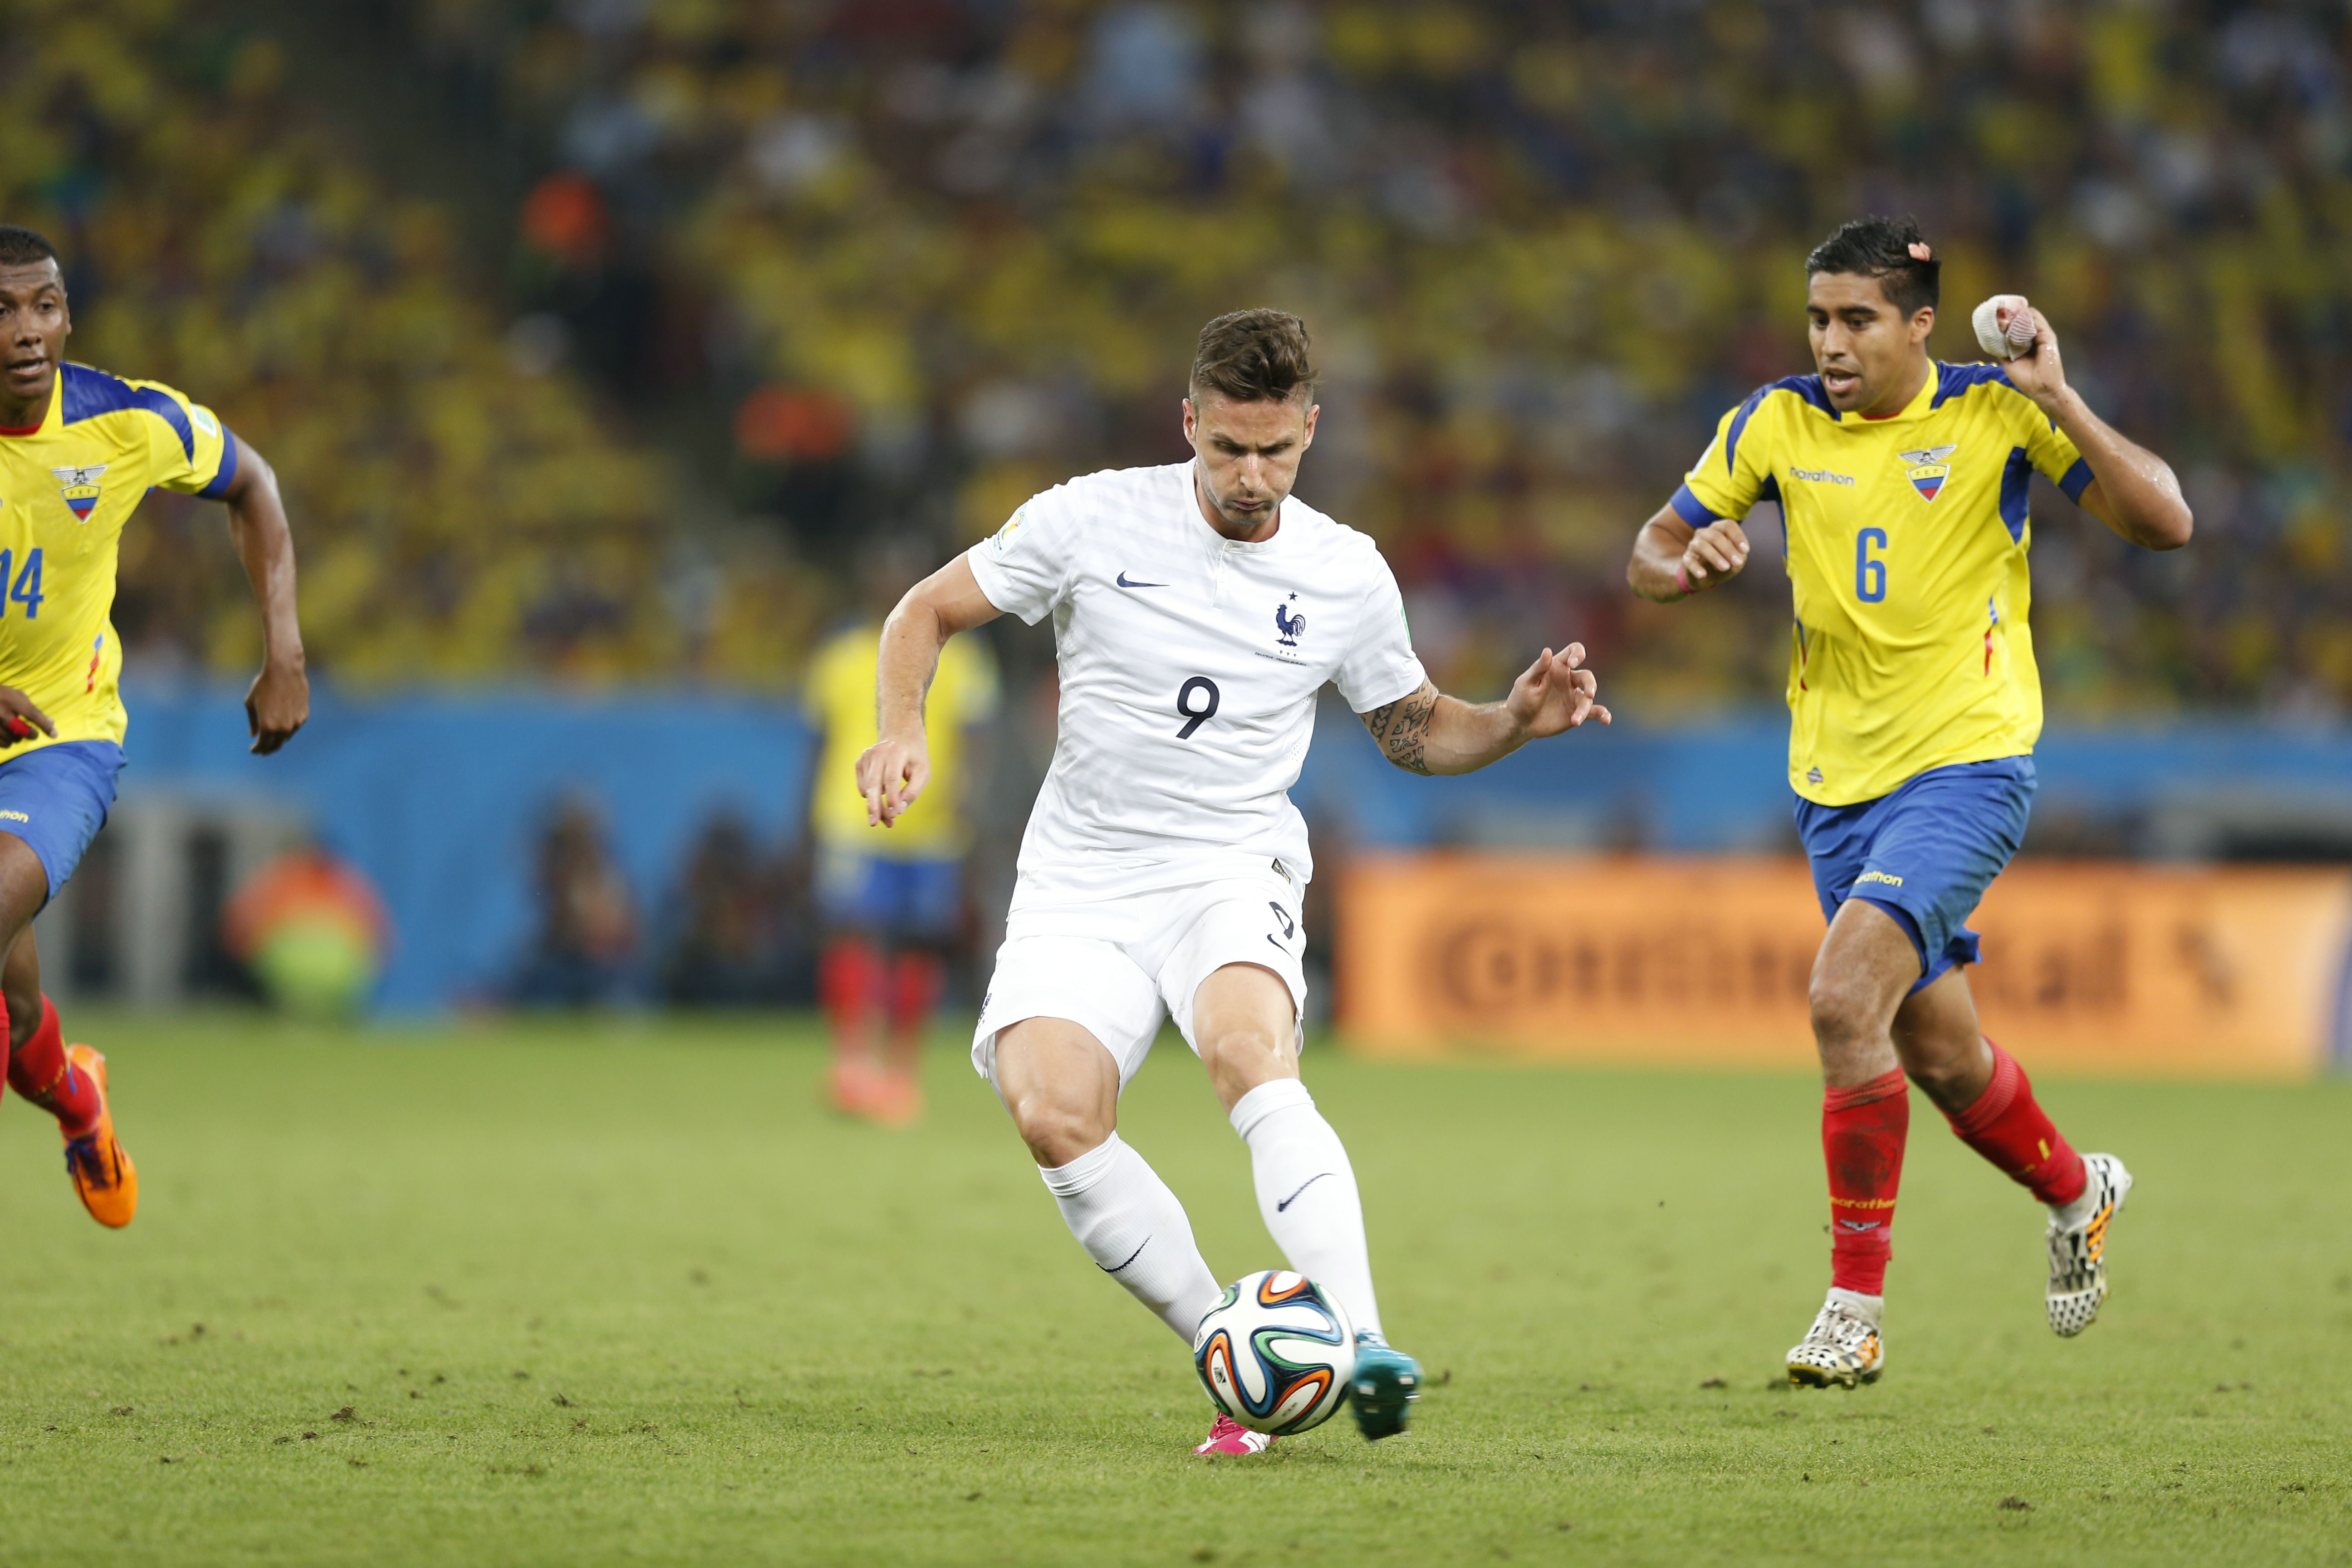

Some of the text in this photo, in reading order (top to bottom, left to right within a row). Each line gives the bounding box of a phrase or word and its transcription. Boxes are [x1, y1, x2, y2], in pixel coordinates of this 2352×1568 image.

[0, 549, 44, 619] 14
[1856, 528, 1886, 603] 6
[1176, 676, 1220, 740] 9
[1269, 901, 1294, 940] 9
